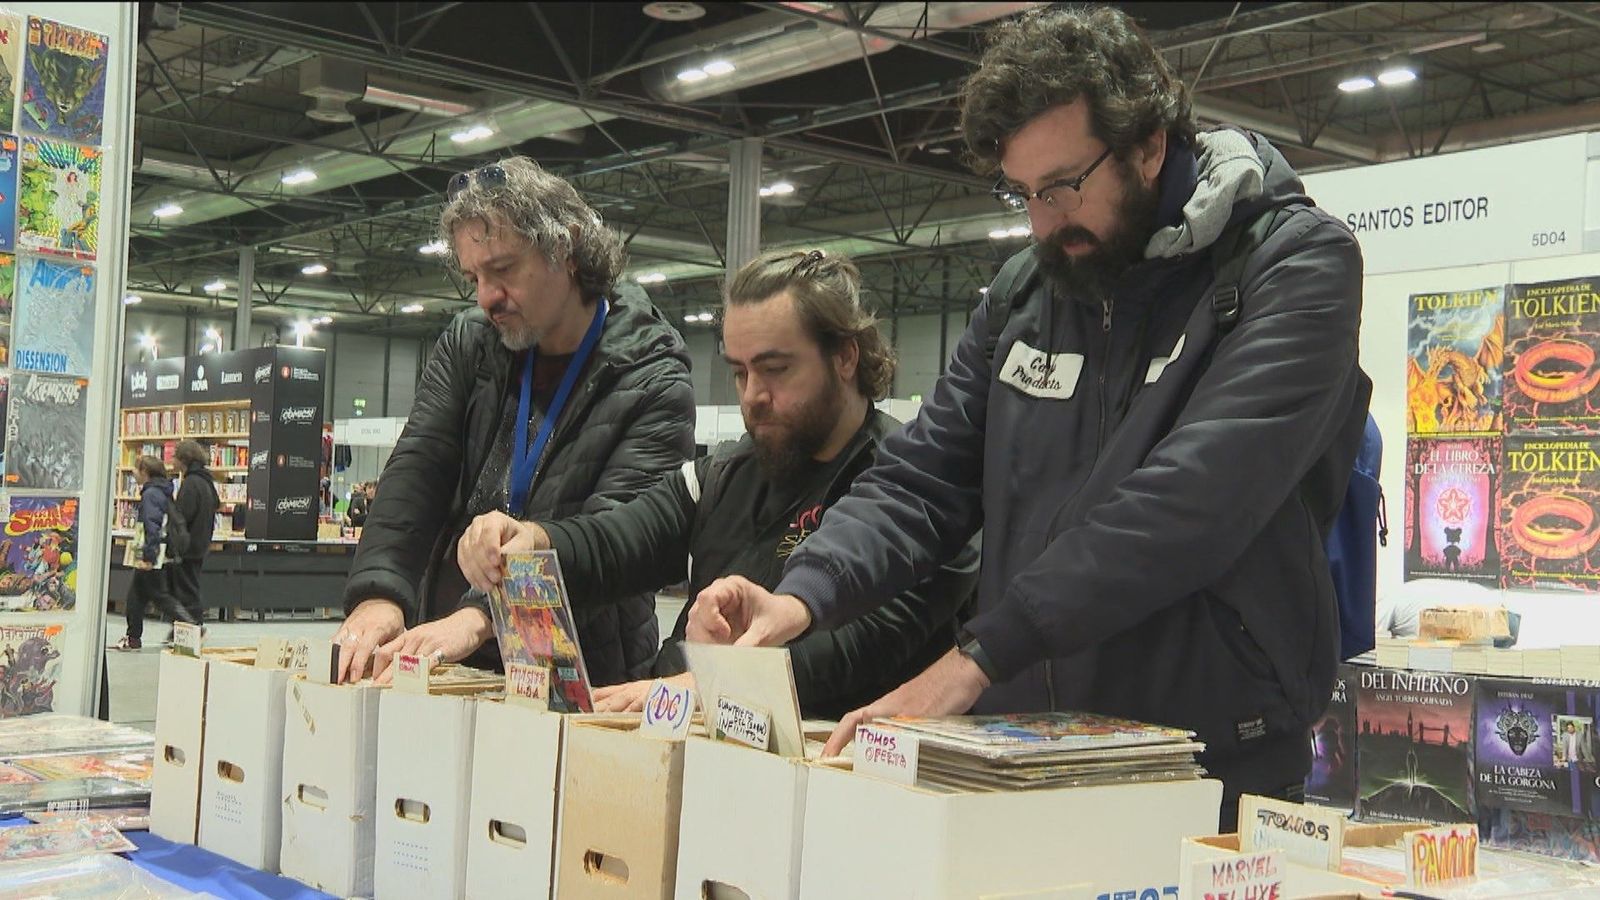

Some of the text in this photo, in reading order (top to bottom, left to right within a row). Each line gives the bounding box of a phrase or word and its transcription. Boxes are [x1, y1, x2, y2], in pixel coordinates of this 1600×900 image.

[1346, 196, 1489, 233] SANTOS EDITOR
[1531, 231, 1566, 247] 5D04
[1414, 290, 1498, 311] TOLKIEN
[191, 379, 208, 392] NOVA
[1445, 449, 1480, 462] LIBRO
[1524, 441, 1579, 450] ENCICLOPEDIA
[1450, 463, 1496, 475] CEREZA
[1507, 450, 1600, 472] TOLKIEN
[1361, 671, 1469, 696] DEL INFIERNO
[858, 727, 897, 751] TOMOS
[865, 746, 907, 769] OFERTA
[1494, 764, 1542, 778] LA CABEZA
[1479, 772, 1557, 791] DE LA GORGONA
[1211, 855, 1277, 889] MARVEL
